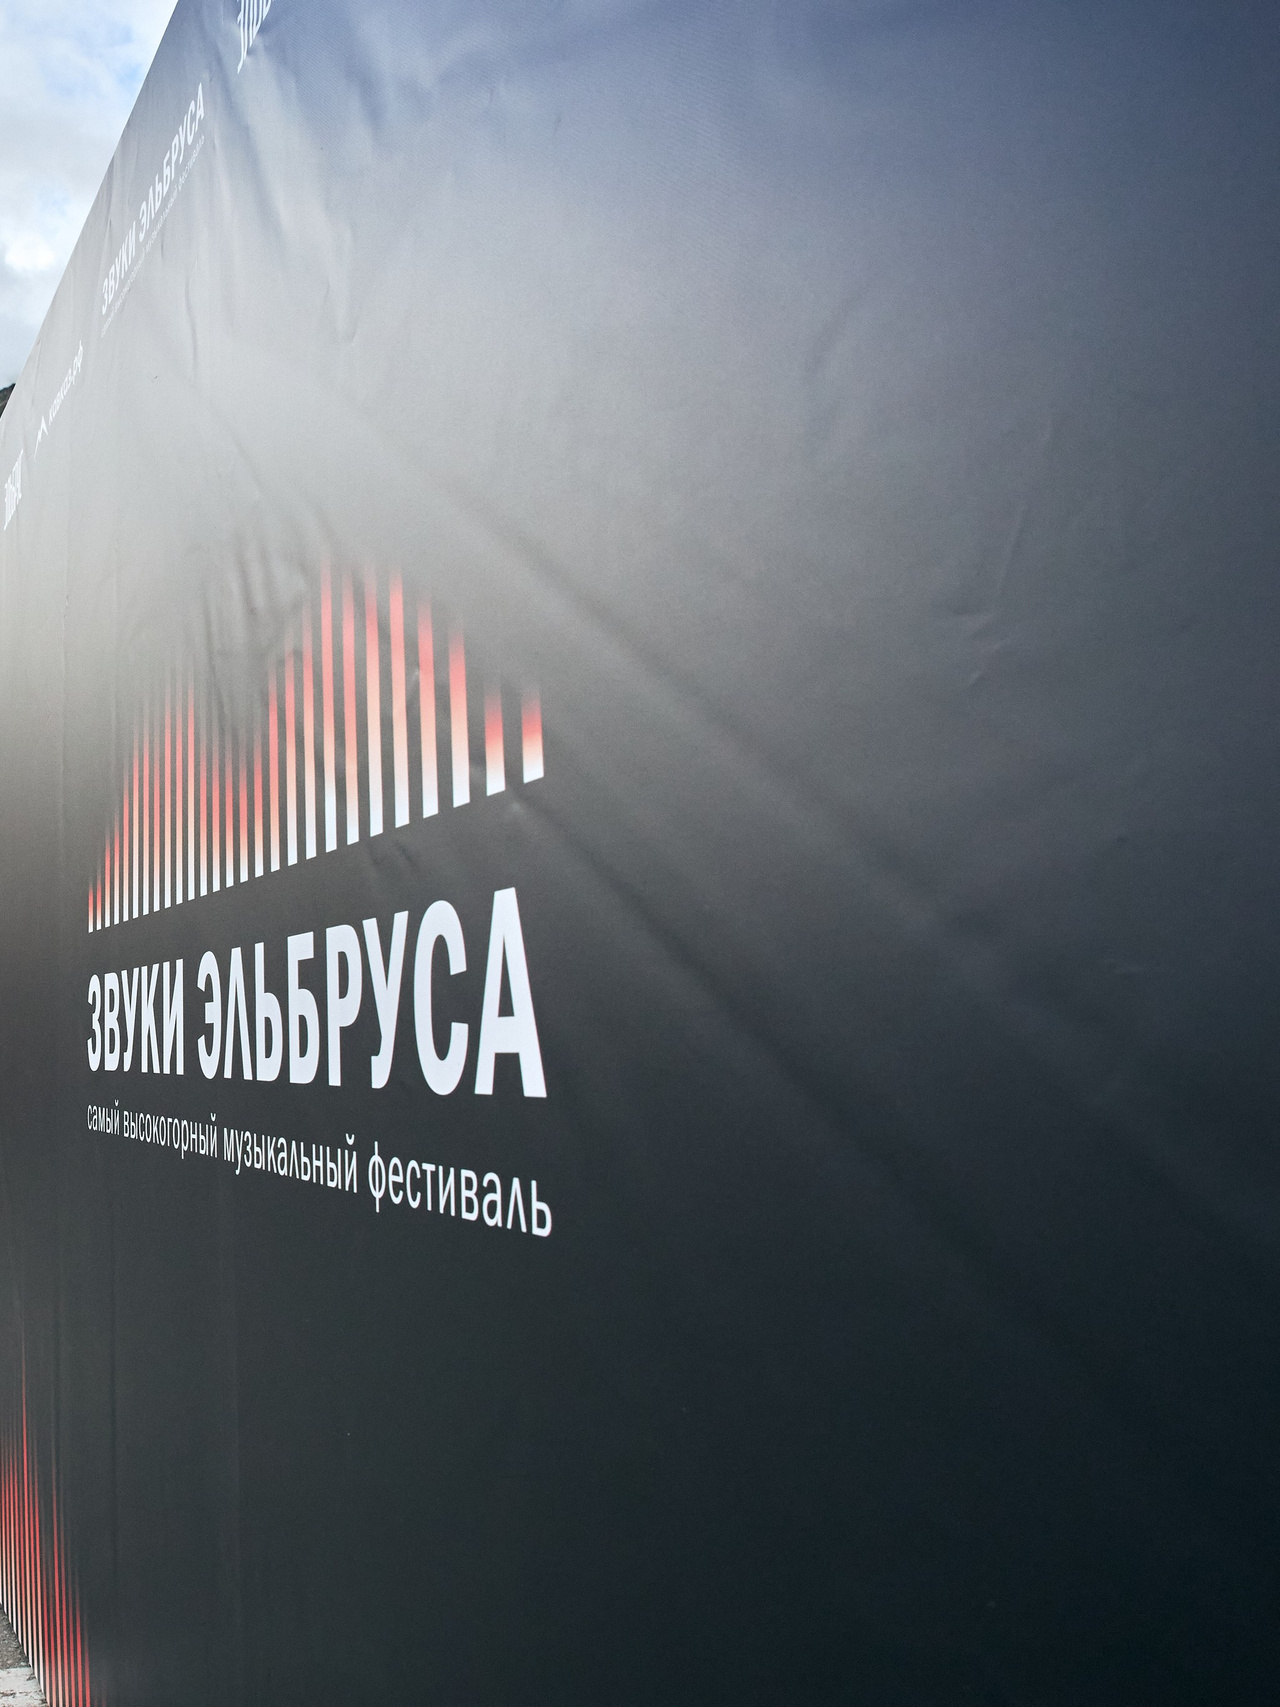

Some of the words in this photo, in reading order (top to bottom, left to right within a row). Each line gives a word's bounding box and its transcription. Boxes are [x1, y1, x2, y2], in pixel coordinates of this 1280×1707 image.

[101, 220, 136, 315] ЗВУКИ
[139, 82, 204, 242] ЭЛЬБРУСА
[87, 958, 184, 1075] ЗВУКИ
[197, 887, 547, 1098] ЭЛЬБРУСА
[87, 1099, 120, 1136] самый
[123, 1110, 217, 1160] высокогорный
[223, 1127, 358, 1193] музыкальный
[368, 1141, 552, 1238] фестиваль
